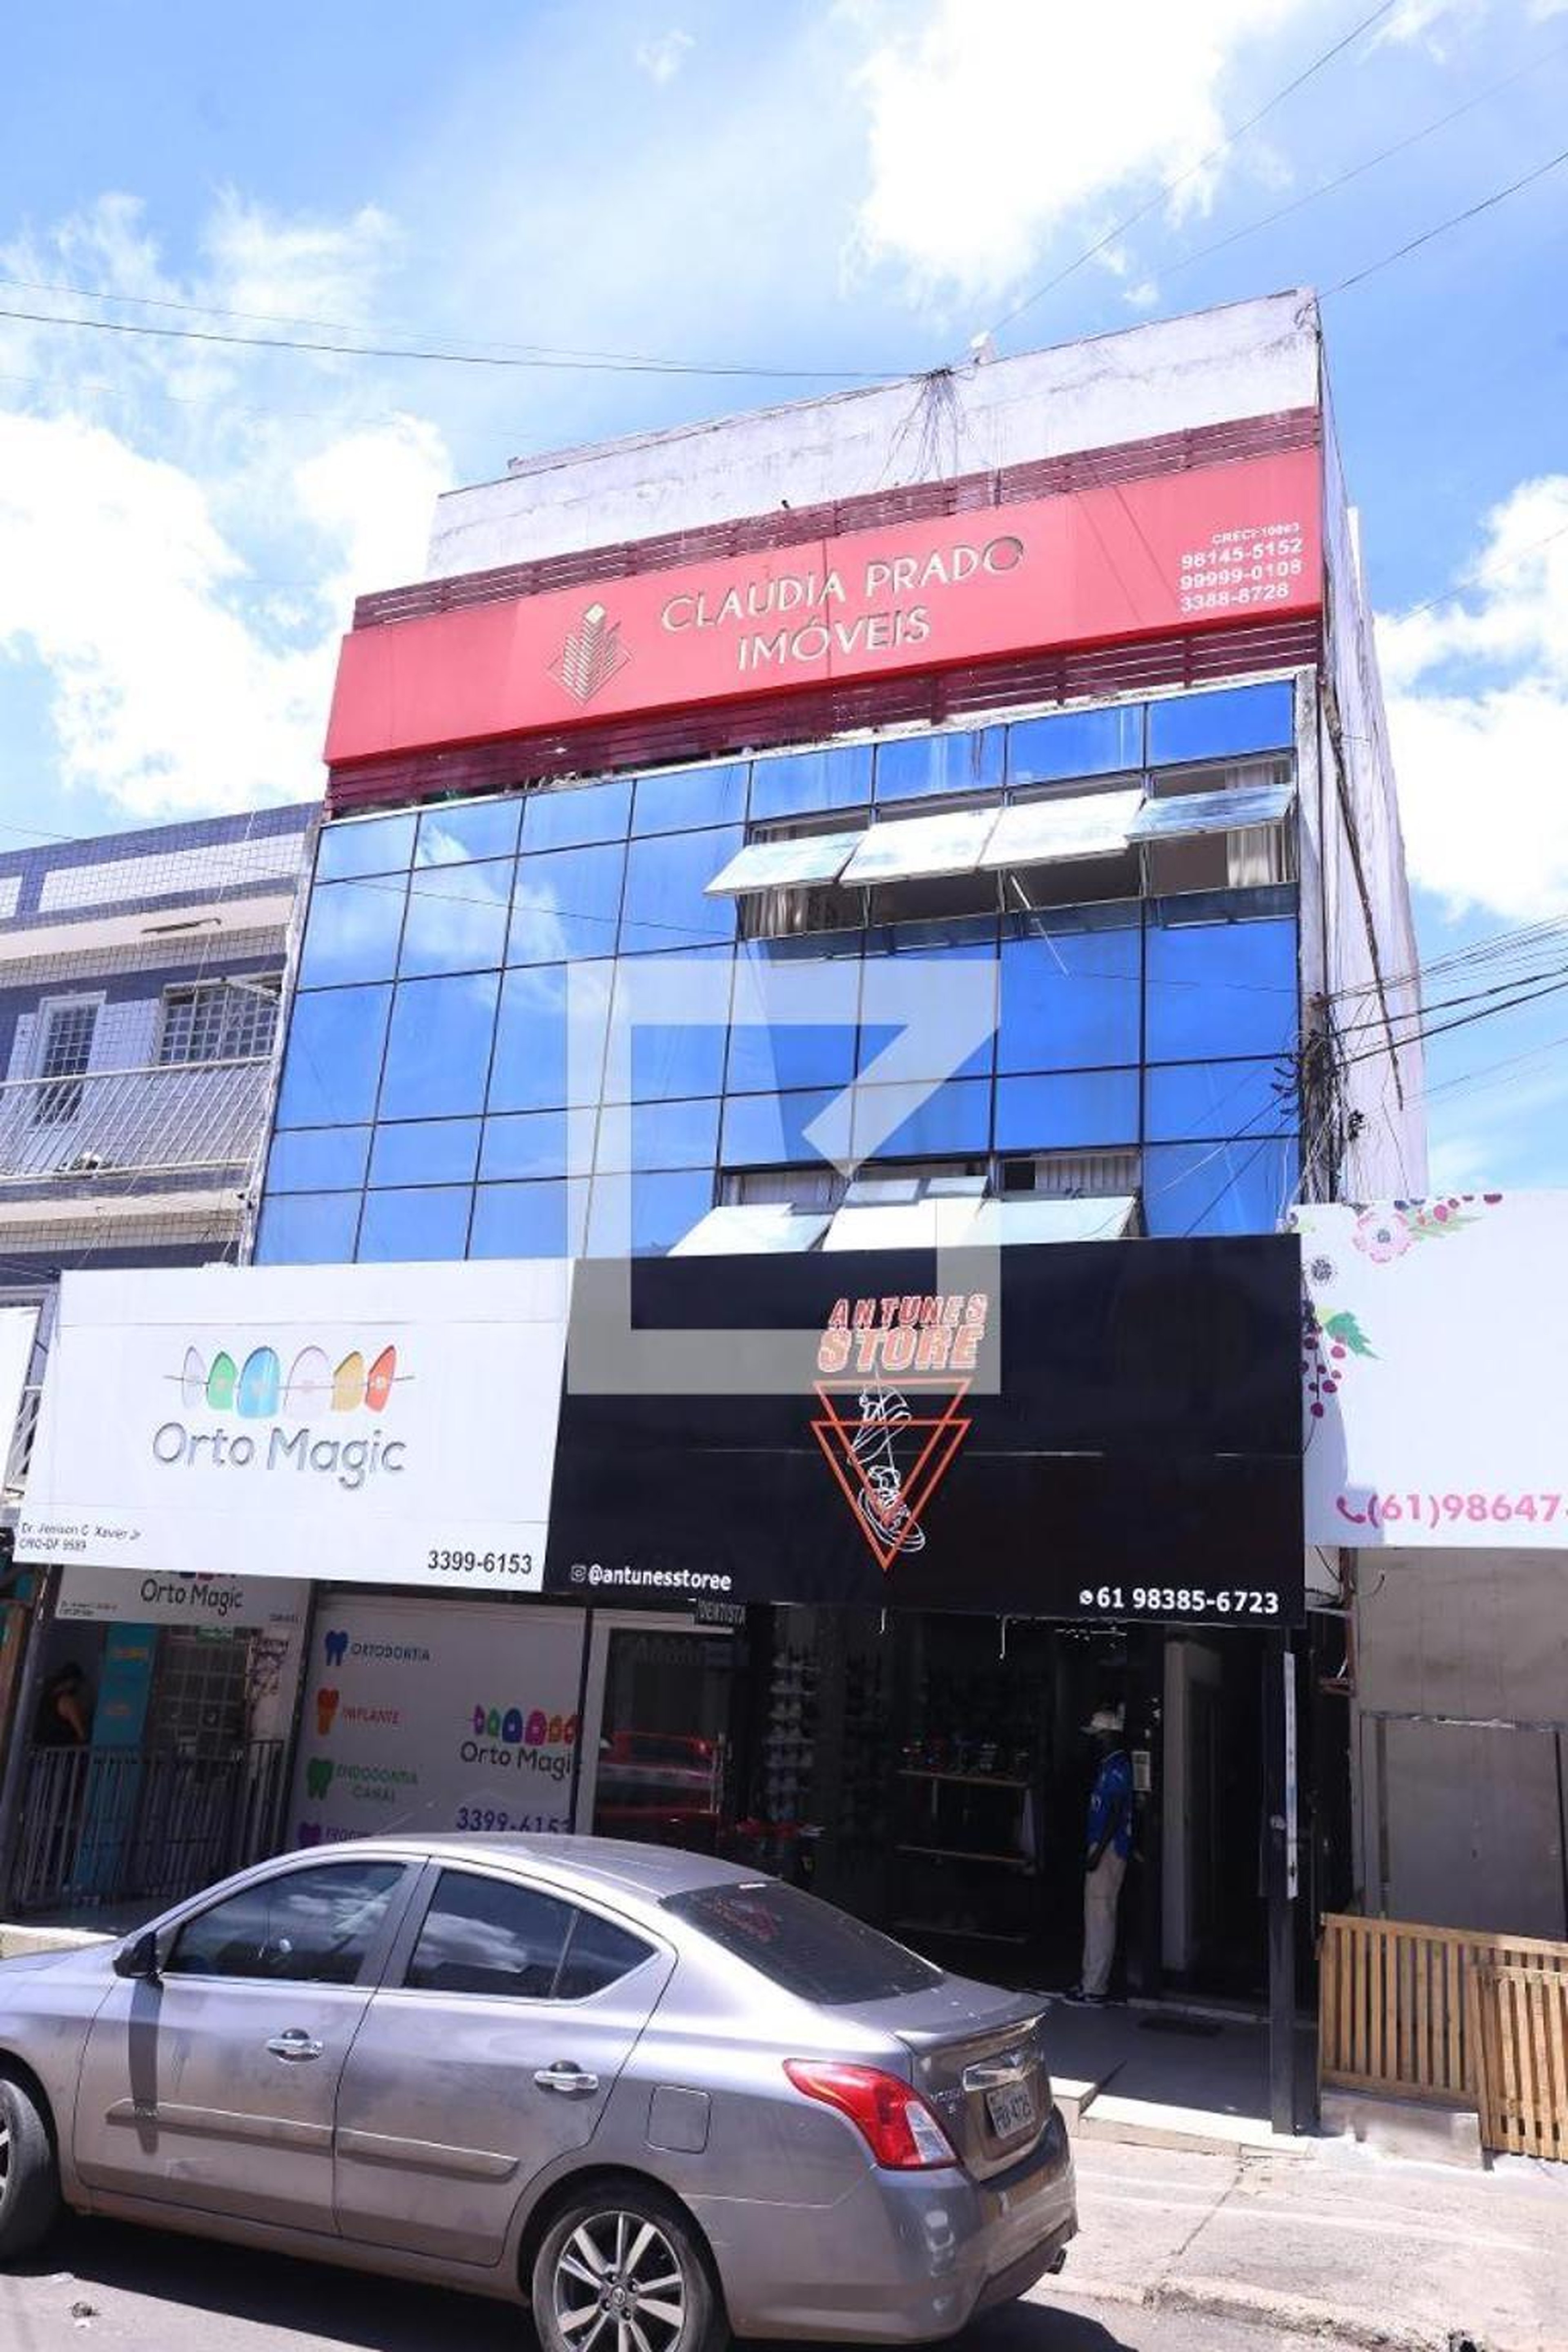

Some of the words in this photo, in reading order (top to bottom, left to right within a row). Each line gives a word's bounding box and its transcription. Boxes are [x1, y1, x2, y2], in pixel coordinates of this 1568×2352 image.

[661, 572, 846, 632] CLAUDIA
[866, 536, 1024, 598] PRADO
[737, 606, 931, 672] IMÓVEIS
[828, 1293, 988, 1328] ANTUNES
[818, 1324, 985, 1372] STORE
[152, 1421, 255, 1468] Orto
[266, 1426, 408, 1490] Magic
[427, 1550, 533, 1575] 3399-6153
[588, 1563, 732, 1591] @antunesstoree
[140, 1578, 186, 1604] Orto
[191, 1583, 244, 1616] Magic
[1096, 1586, 1125, 1608] 61
[1132, 1587, 1280, 1614] 98385-6723
[460, 1741, 511, 1766] Orto
[517, 1747, 572, 1781] Magi
